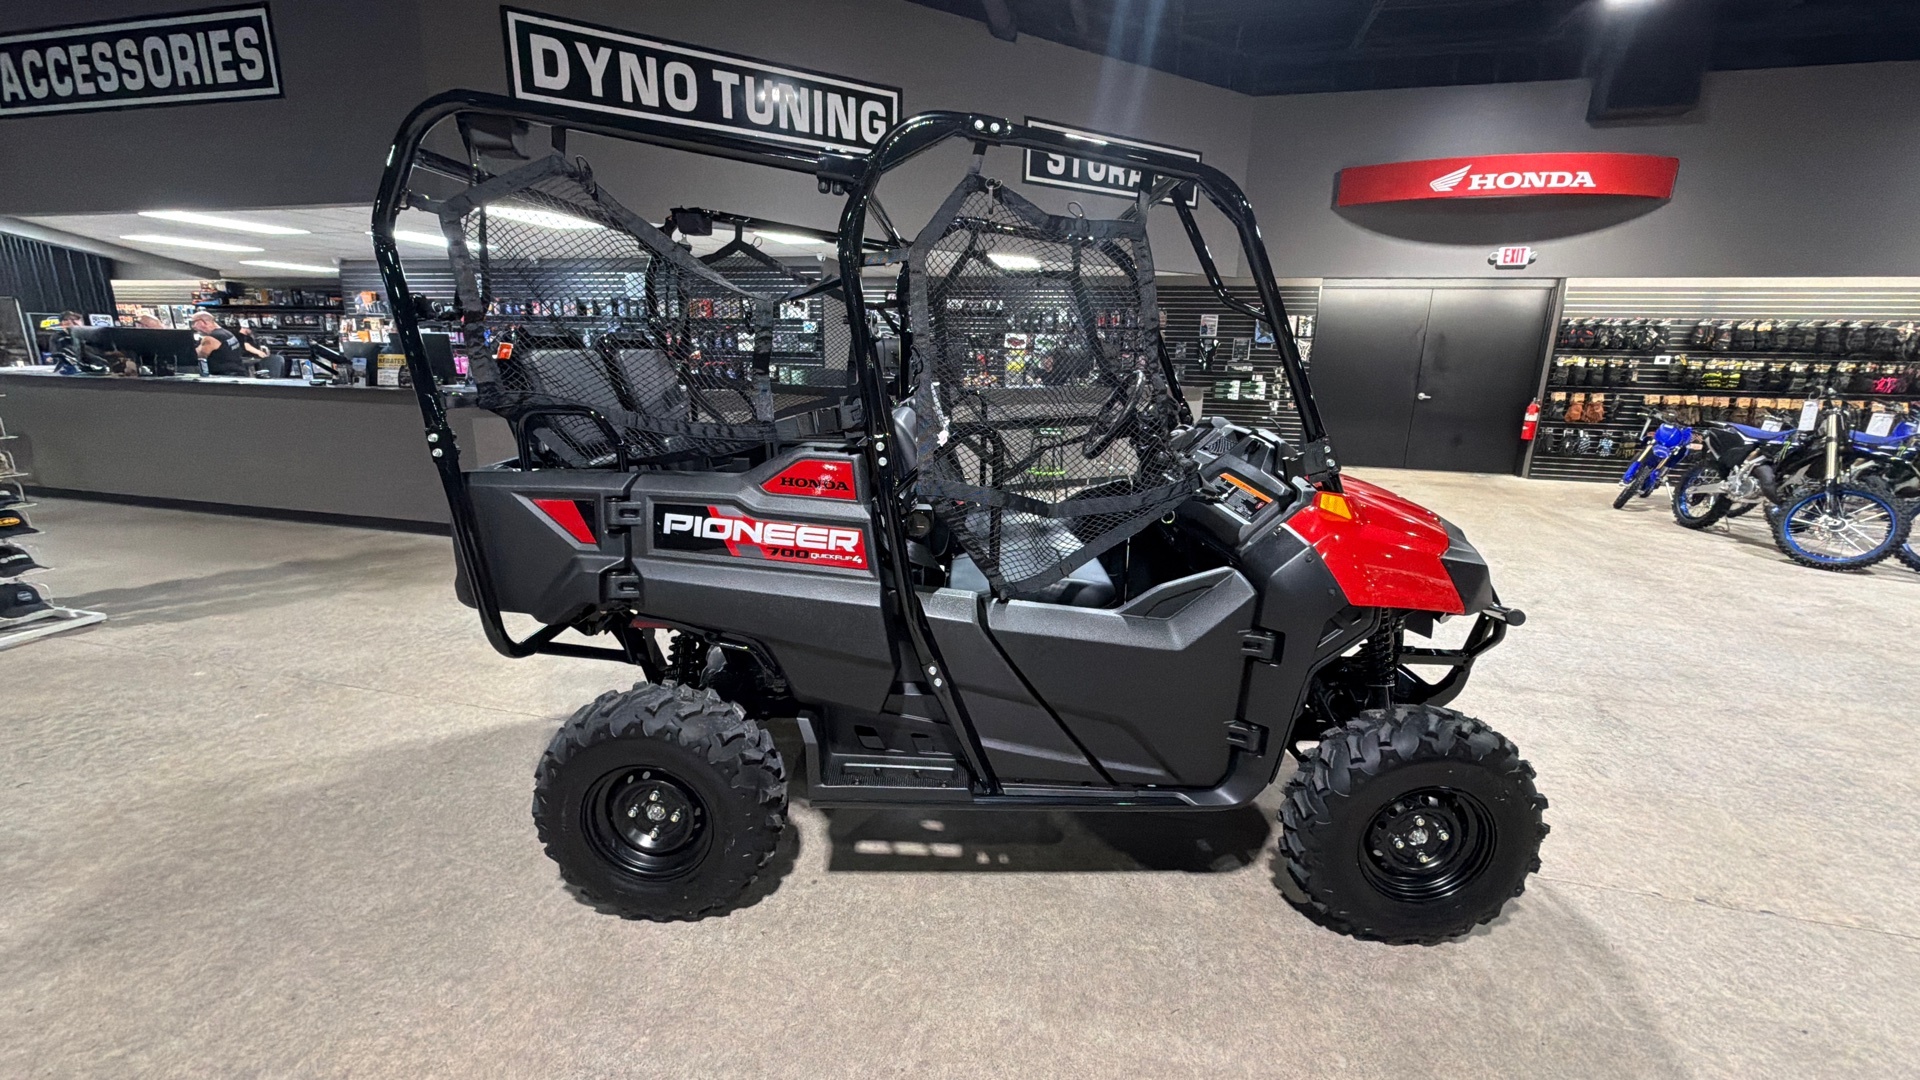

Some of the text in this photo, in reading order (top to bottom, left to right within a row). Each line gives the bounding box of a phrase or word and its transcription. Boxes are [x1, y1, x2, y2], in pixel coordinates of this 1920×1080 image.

[0, 26, 265, 102] ACCESSORIES
[529, 32, 888, 144] DYNO TUNING
[1467, 171, 1596, 190] HONDA
[1503, 248, 1526, 264] EXIT
[780, 476, 849, 491] HONDA
[663, 513, 860, 552] PIONEER
[766, 547, 809, 559] 700
